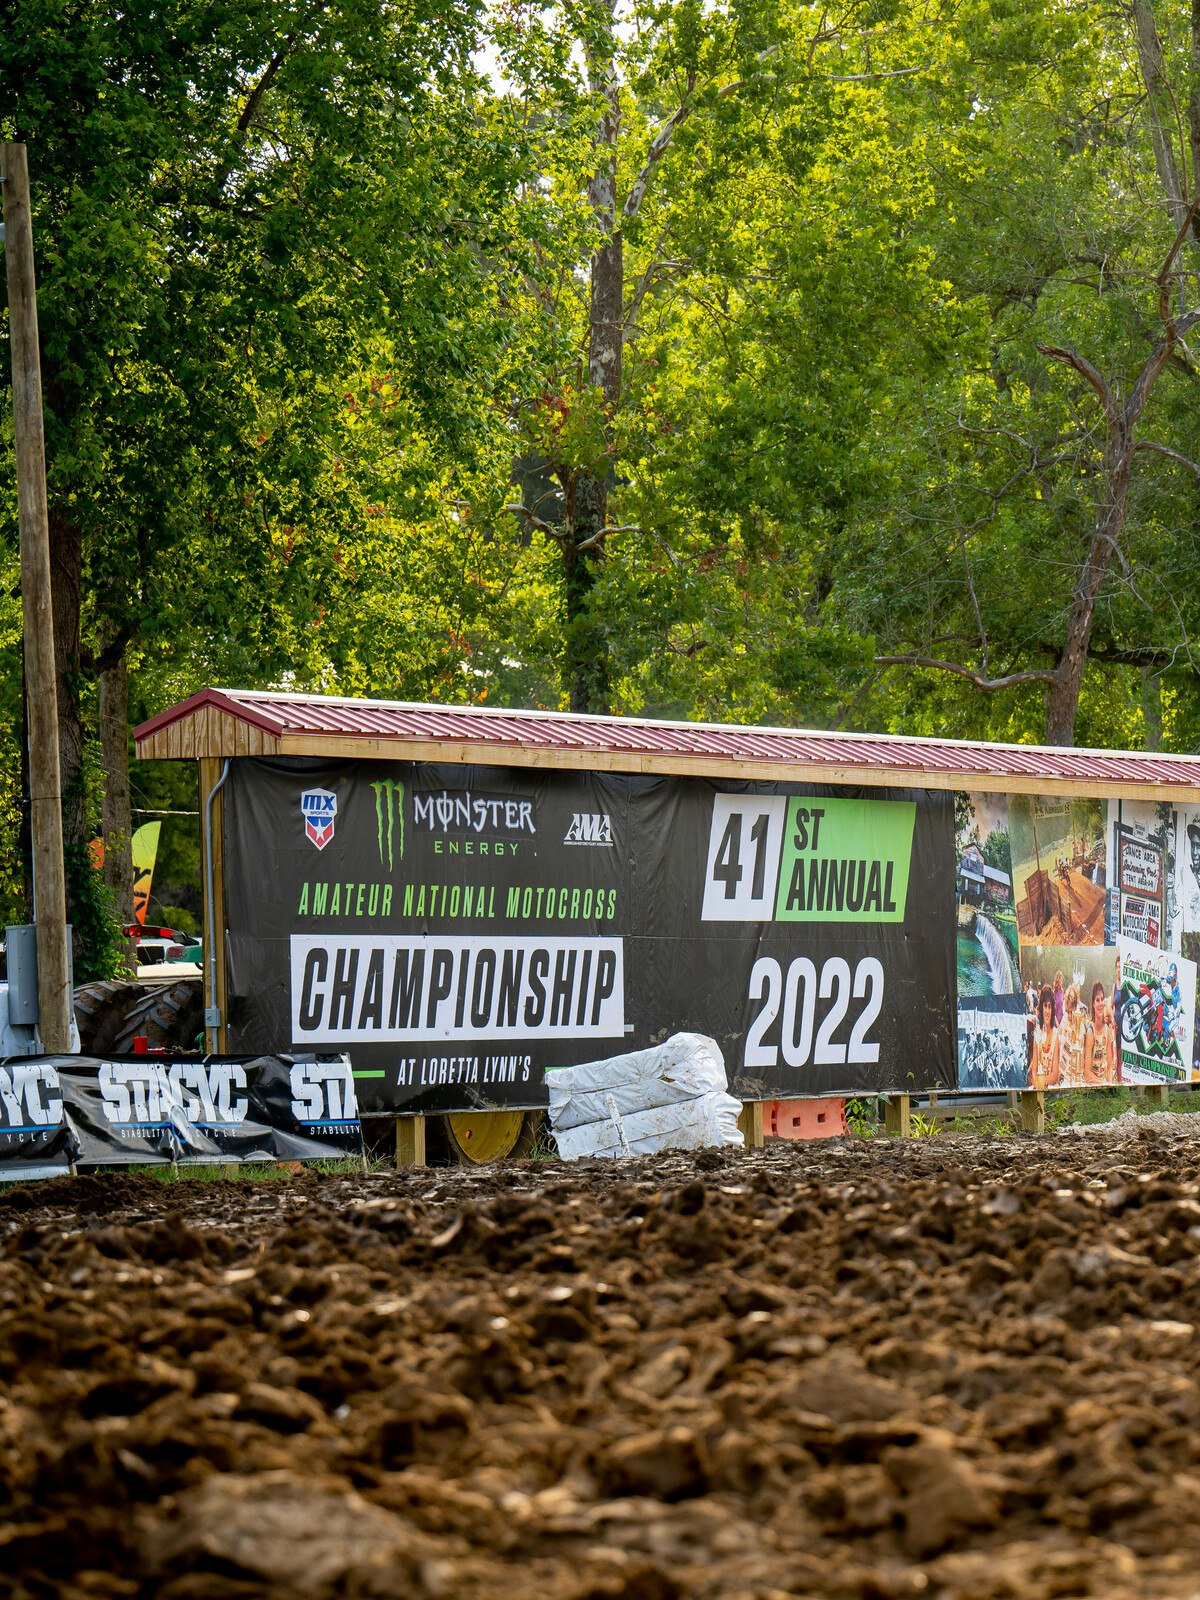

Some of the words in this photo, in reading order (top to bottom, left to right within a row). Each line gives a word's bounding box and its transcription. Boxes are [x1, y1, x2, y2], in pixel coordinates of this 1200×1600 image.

[303, 795, 335, 811] MX
[563, 813, 613, 842] AMA
[794, 808, 825, 851] ST
[434, 840, 519, 856] ENERGY
[713, 813, 770, 900] 41
[298, 882, 393, 916] AMATEUR
[402, 884, 496, 918] NATIONAL
[506, 887, 617, 919] MOTOCROSS
[785, 858, 896, 912] ANNUAL
[299, 947, 616, 1031] CHAMPIONSHIP
[744, 956, 884, 1067] 2022
[397, 1059, 416, 1086] AT
[421, 1057, 479, 1085] LORETTA
[483, 1055, 531, 1082] LYNN'S
[99, 1063, 249, 1123] STACYC
[310, 1125, 360, 1136] STABILITY
